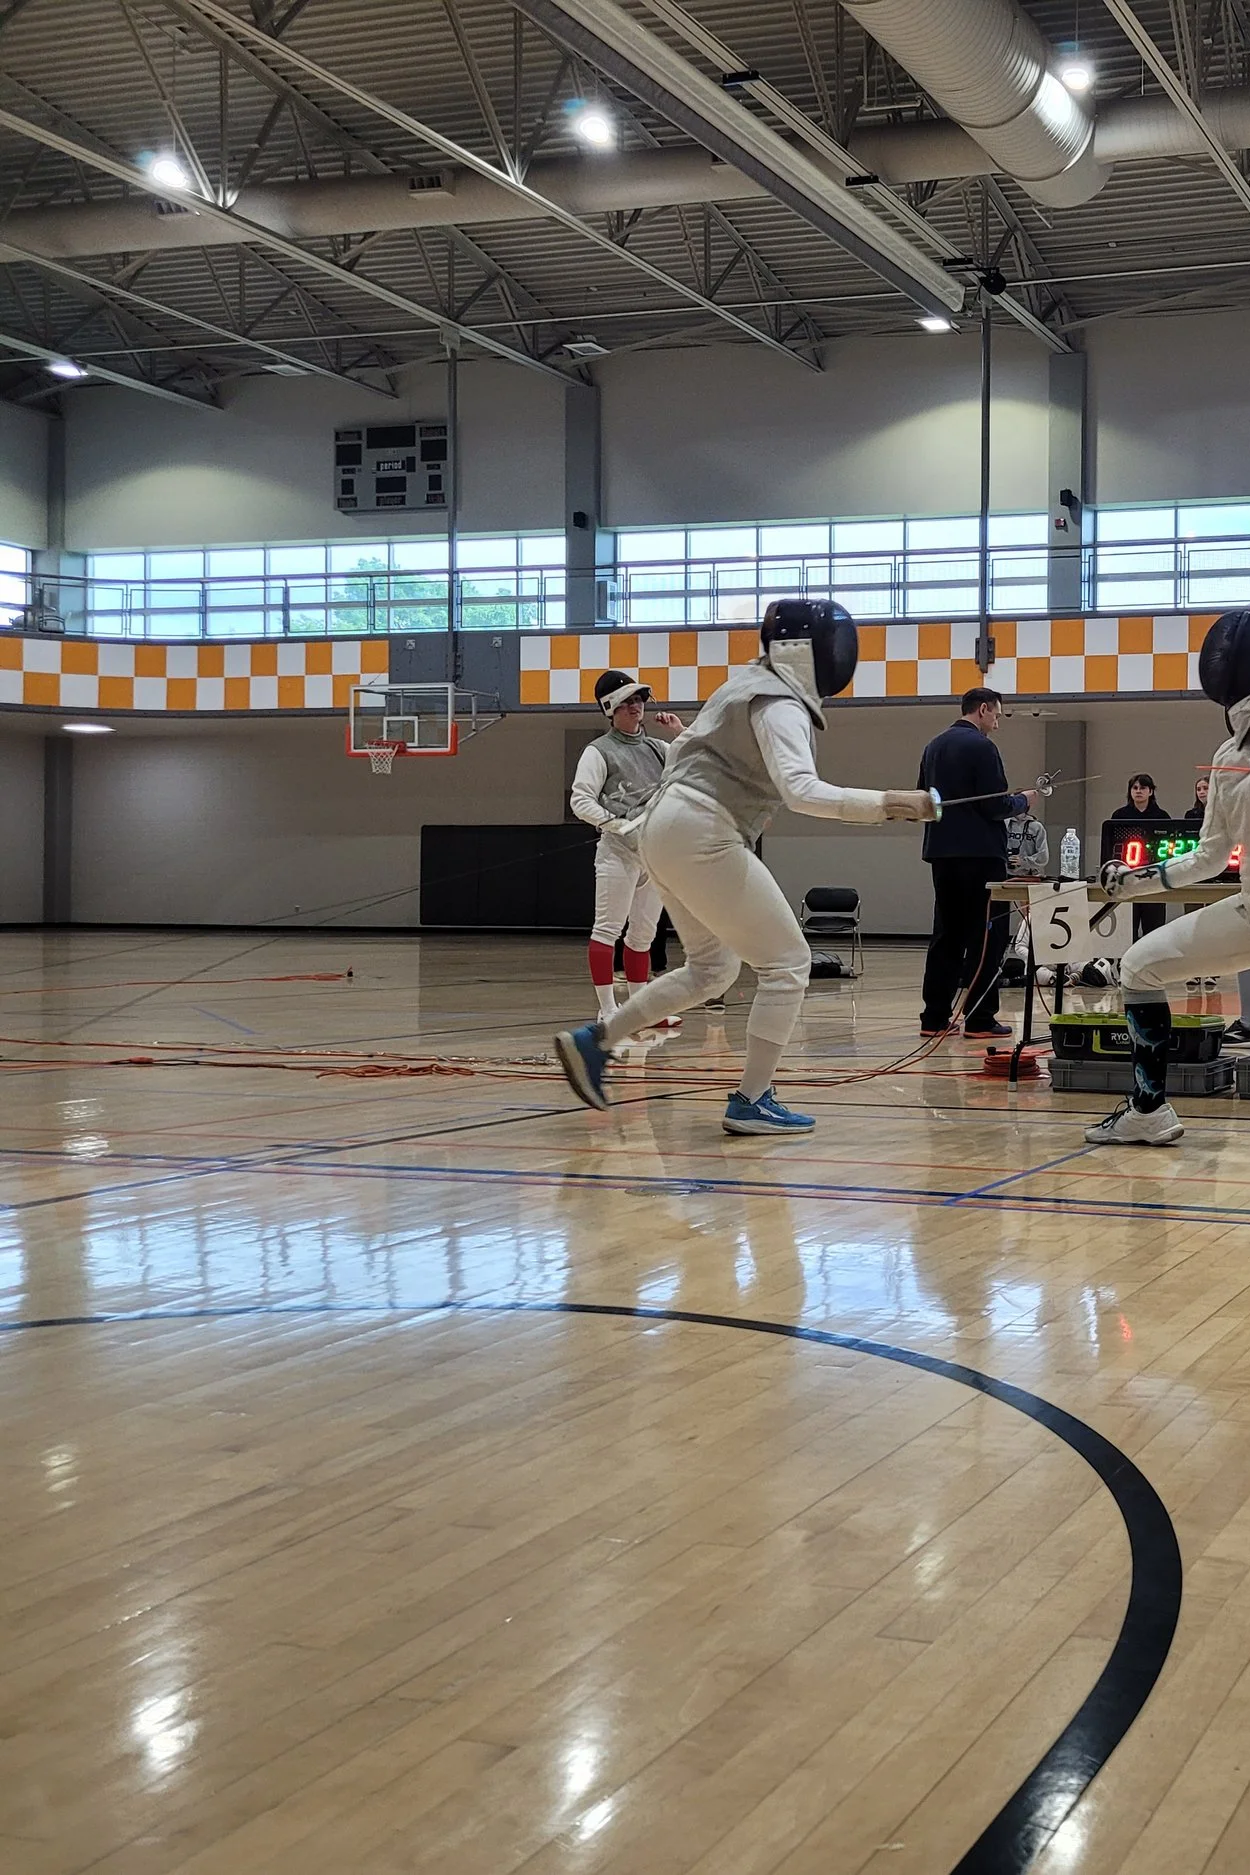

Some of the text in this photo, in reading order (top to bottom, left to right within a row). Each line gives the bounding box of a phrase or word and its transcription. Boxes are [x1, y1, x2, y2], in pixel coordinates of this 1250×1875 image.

[380, 461, 402, 471] period
[1050, 906, 1072, 950] 5
[1110, 1032, 1130, 1041] RYO
